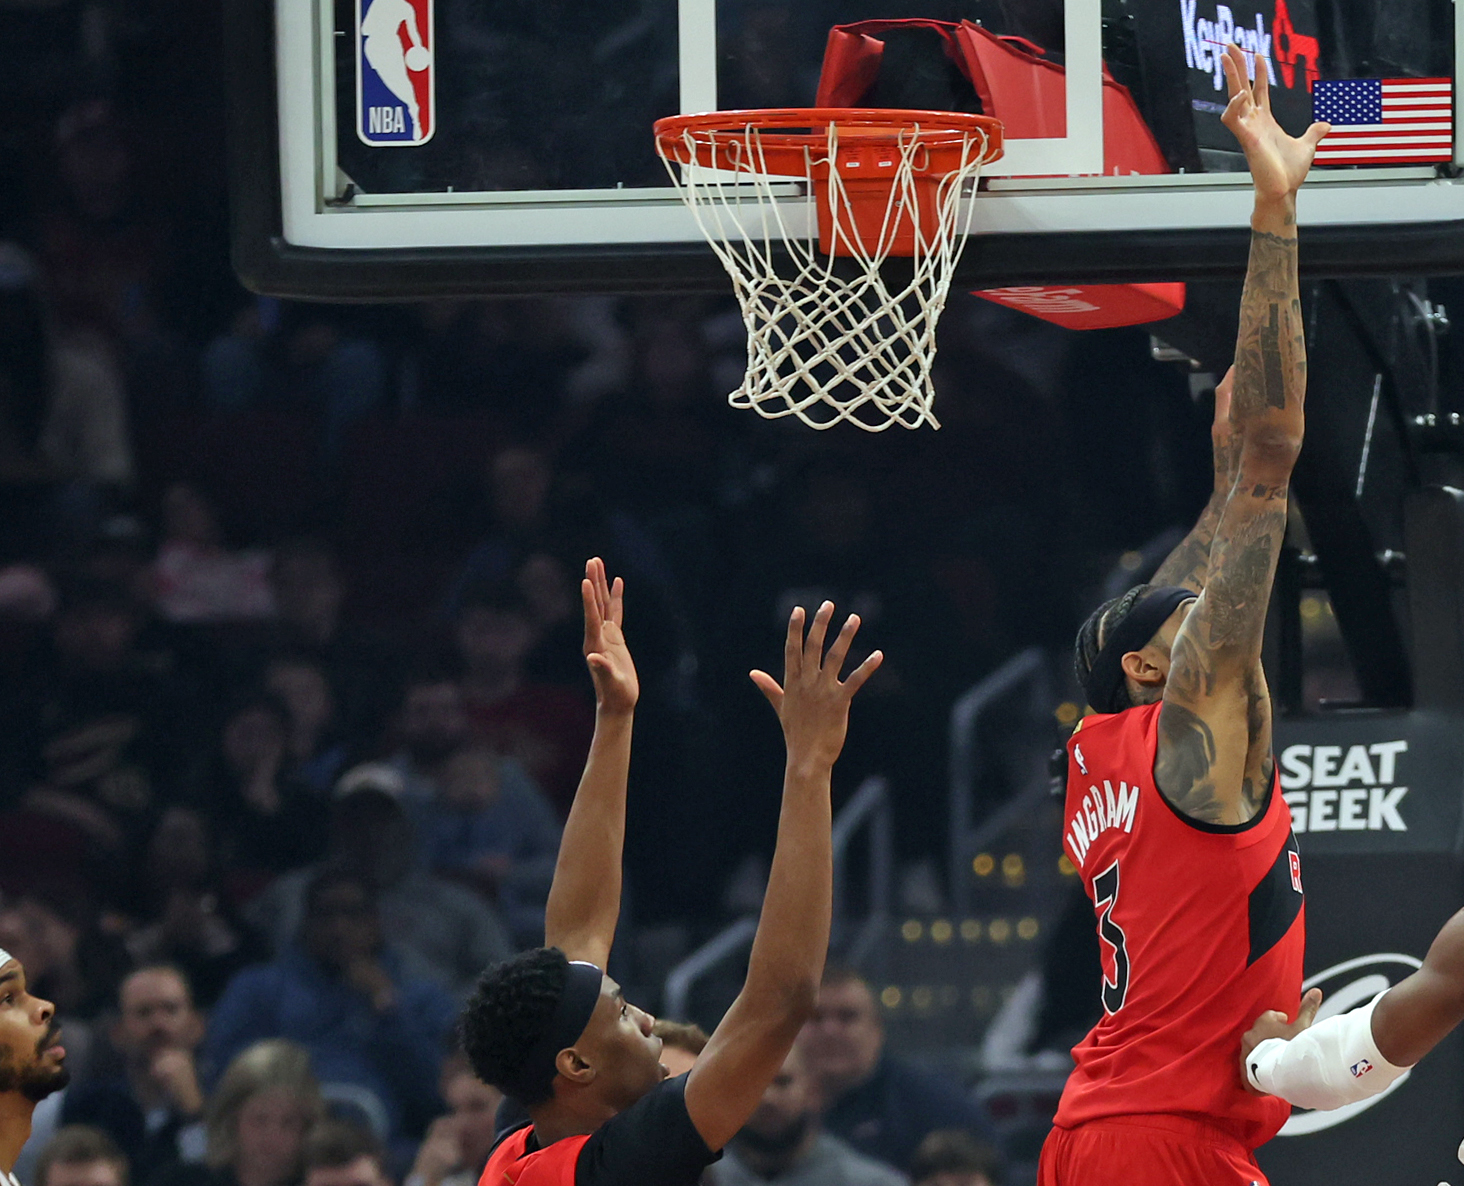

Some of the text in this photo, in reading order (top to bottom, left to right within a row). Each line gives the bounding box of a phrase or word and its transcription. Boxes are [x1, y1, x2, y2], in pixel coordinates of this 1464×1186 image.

[368, 106, 406, 134] NBA
[1280, 740, 1408, 789] SEAT
[1066, 779, 1140, 868] INGRAM
[1282, 787, 1409, 834] GEEK
[1092, 858, 1131, 1017] 3
